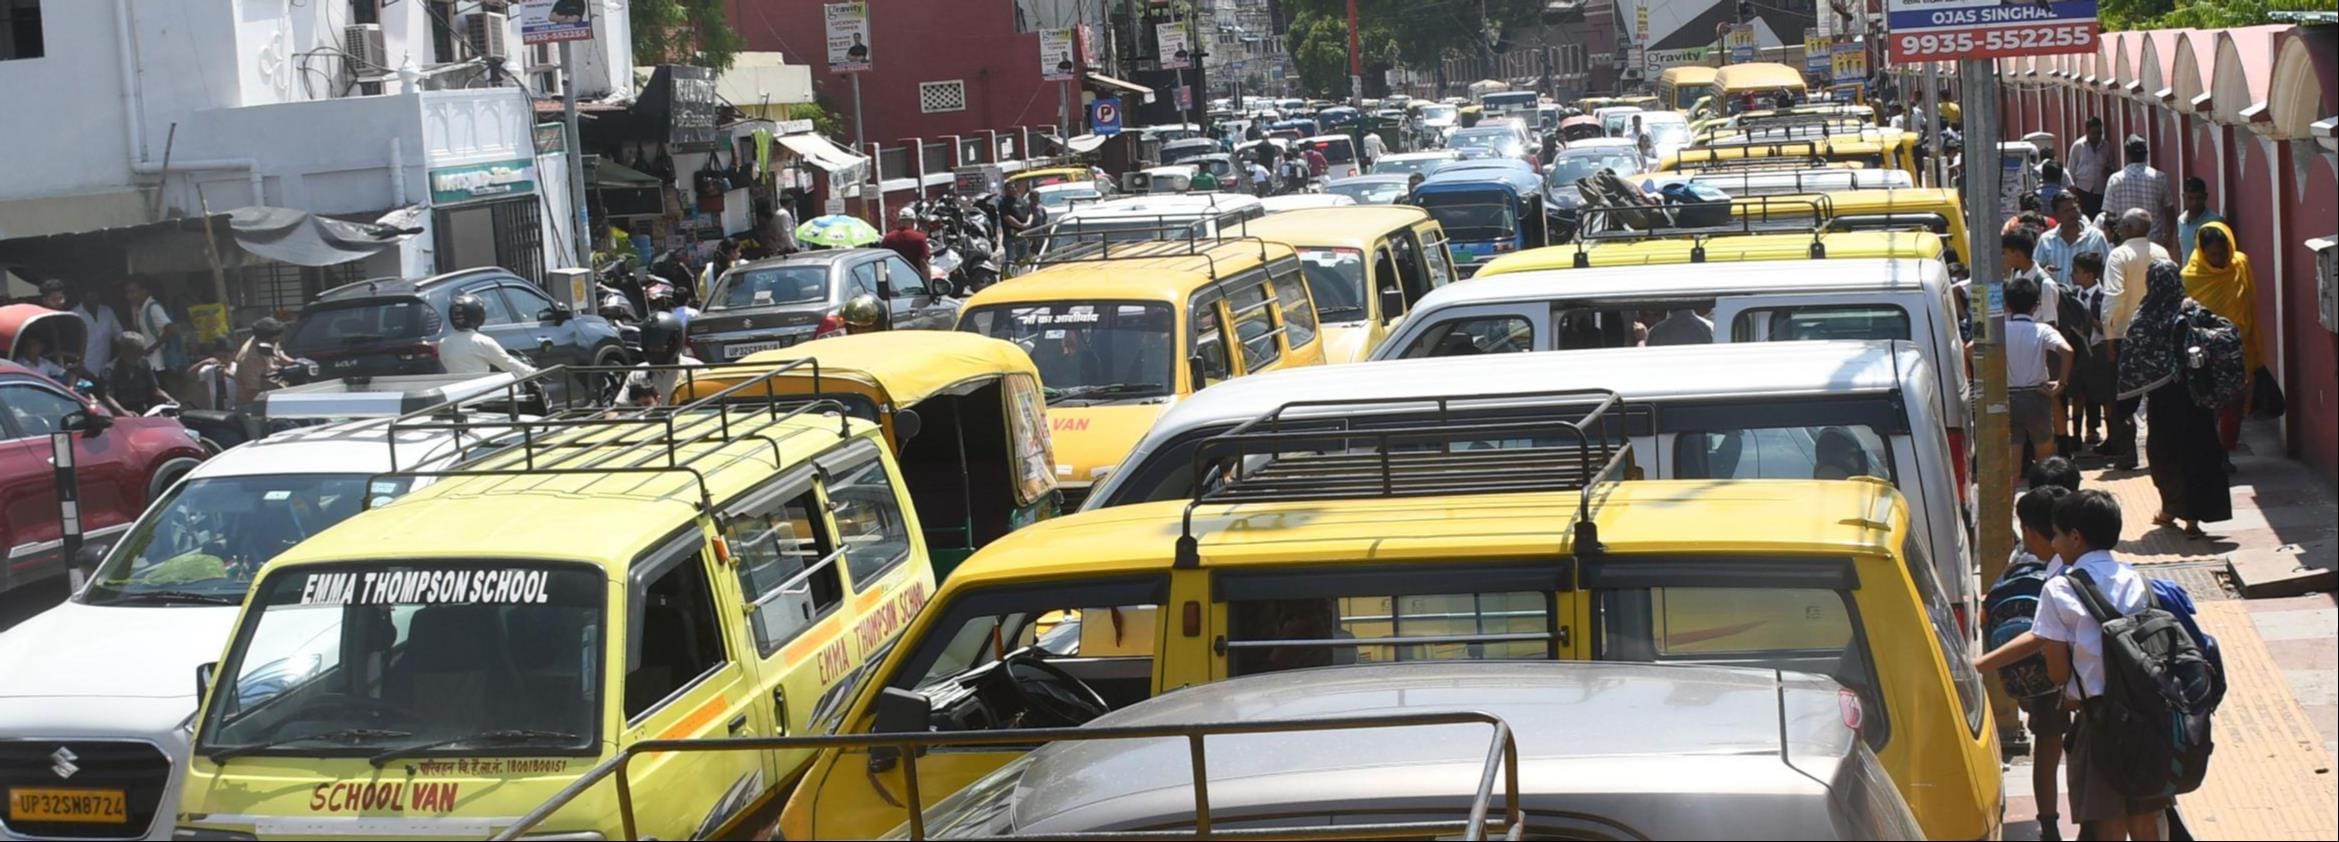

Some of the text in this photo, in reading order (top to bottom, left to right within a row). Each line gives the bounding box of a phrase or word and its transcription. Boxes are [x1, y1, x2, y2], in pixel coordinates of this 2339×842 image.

[1931, 6, 2058, 25] OJAS SINGHAL
[1901, 26, 2091, 55] 9935-552255
[1647, 51, 1700, 72] gravity
[1053, 418, 1090, 431] VAN
[300, 570, 549, 605] EMMA THOMPSON SCHOOL
[816, 637, 850, 686] EMMA
[853, 598, 898, 661] THOMPSON
[309, 782, 459, 813] SCHOOL VAN
